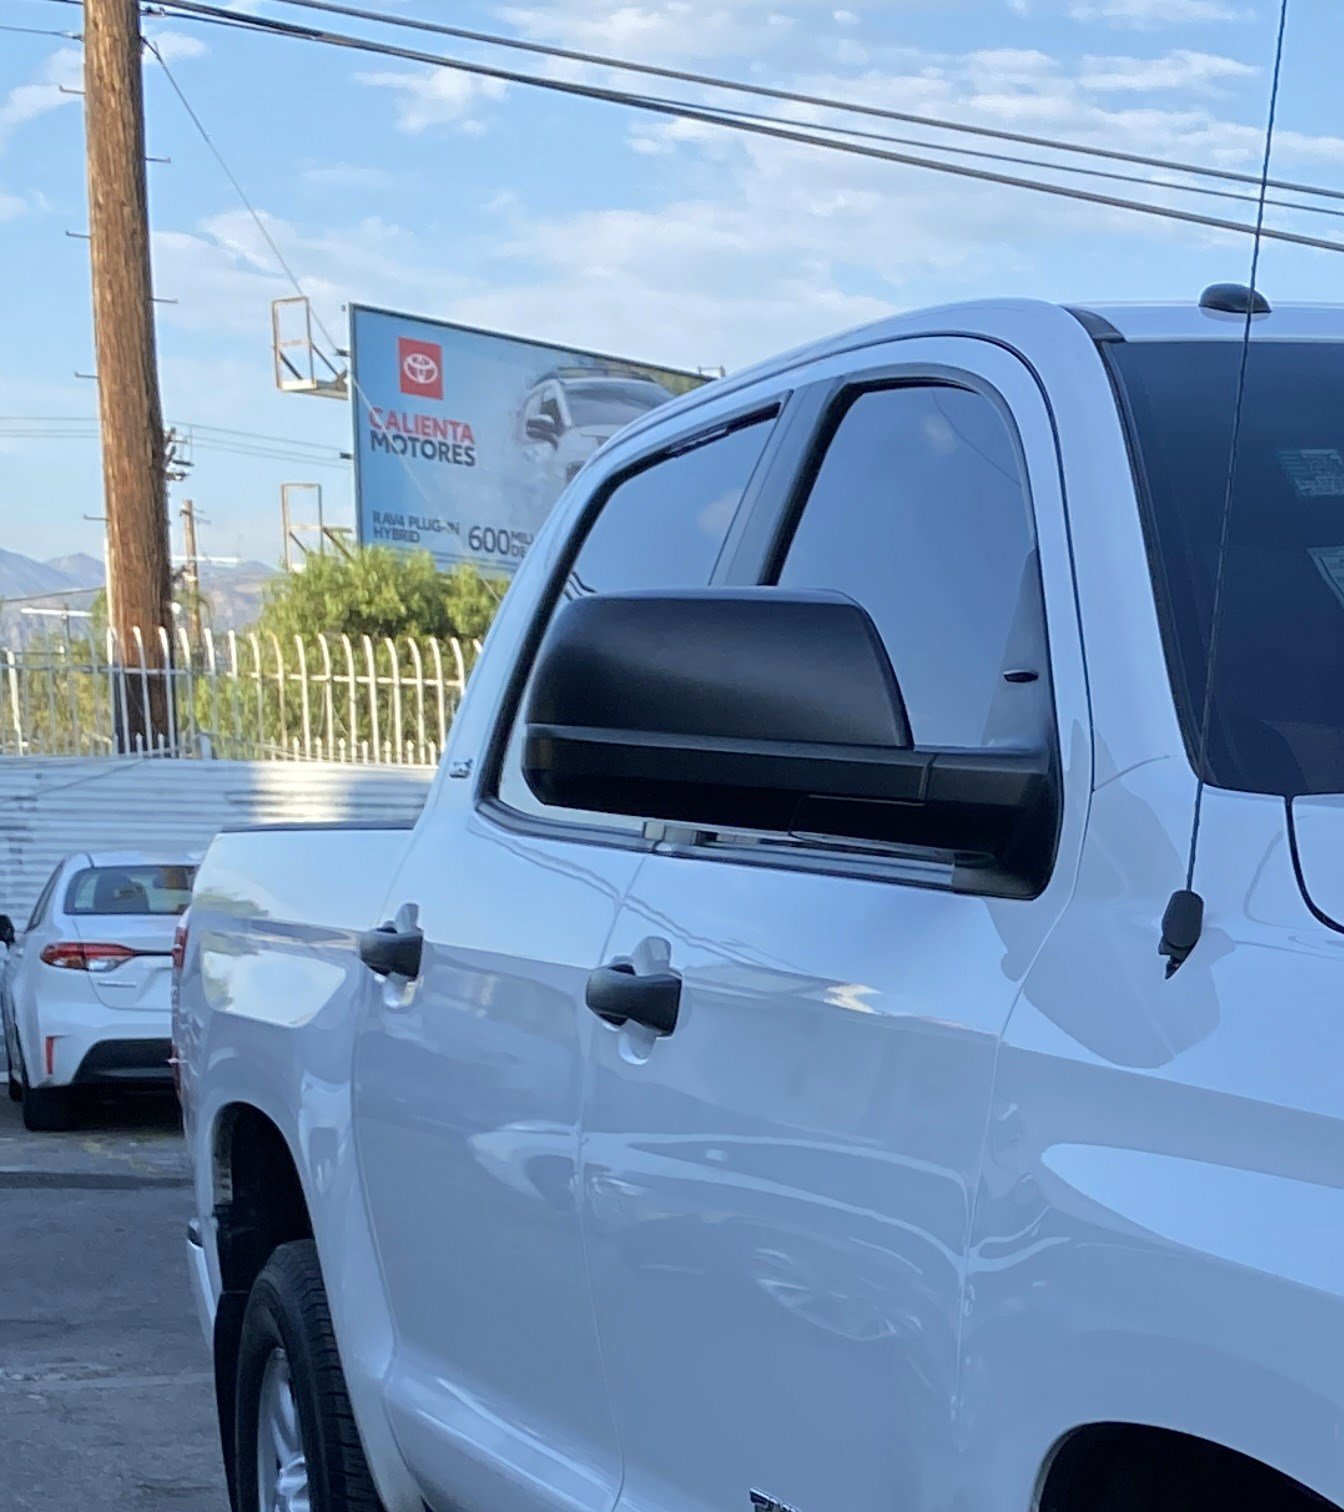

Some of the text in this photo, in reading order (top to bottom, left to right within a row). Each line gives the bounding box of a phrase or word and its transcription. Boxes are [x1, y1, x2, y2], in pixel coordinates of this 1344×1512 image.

[368, 406, 475, 445] CALIENTA
[370, 429, 476, 467] MOTORES
[373, 526, 421, 544] HYBRID
[408, 514, 460, 536] PLUG-IN
[468, 525, 511, 555] 600
